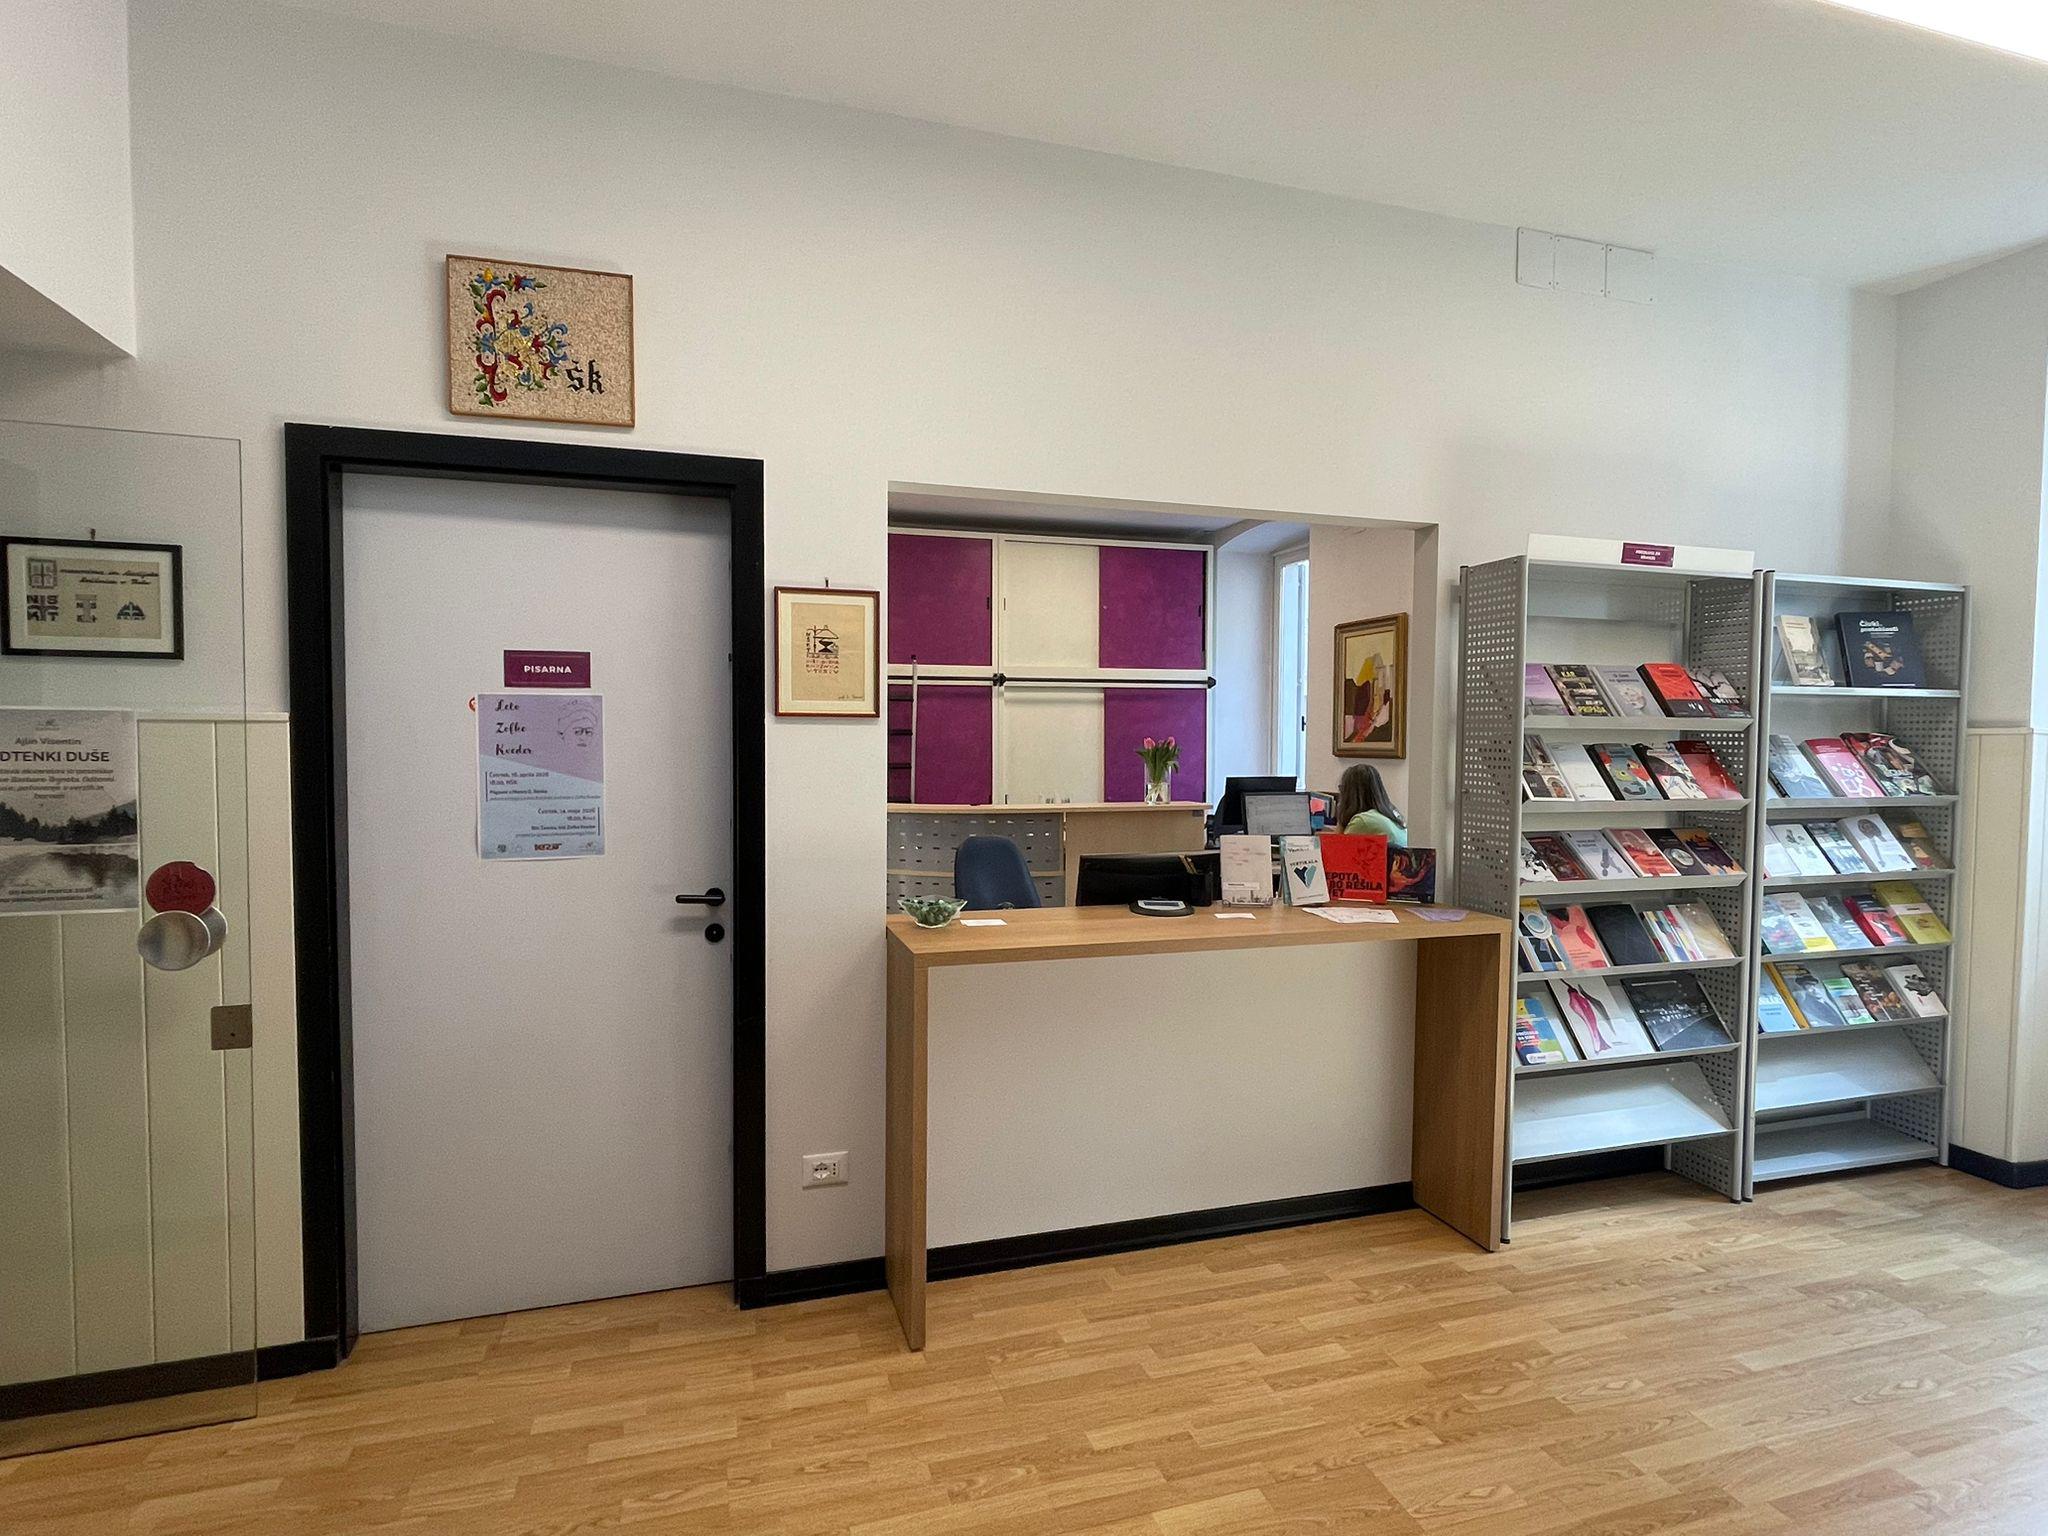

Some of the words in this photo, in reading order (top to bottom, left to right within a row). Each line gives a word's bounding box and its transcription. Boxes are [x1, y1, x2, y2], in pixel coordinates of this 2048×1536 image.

[523, 664, 573, 674] PISARNA
[495, 699, 520, 712] Leto
[66, 748, 110, 762] DUŠE
[1345, 879, 1383, 891] REŠILA
